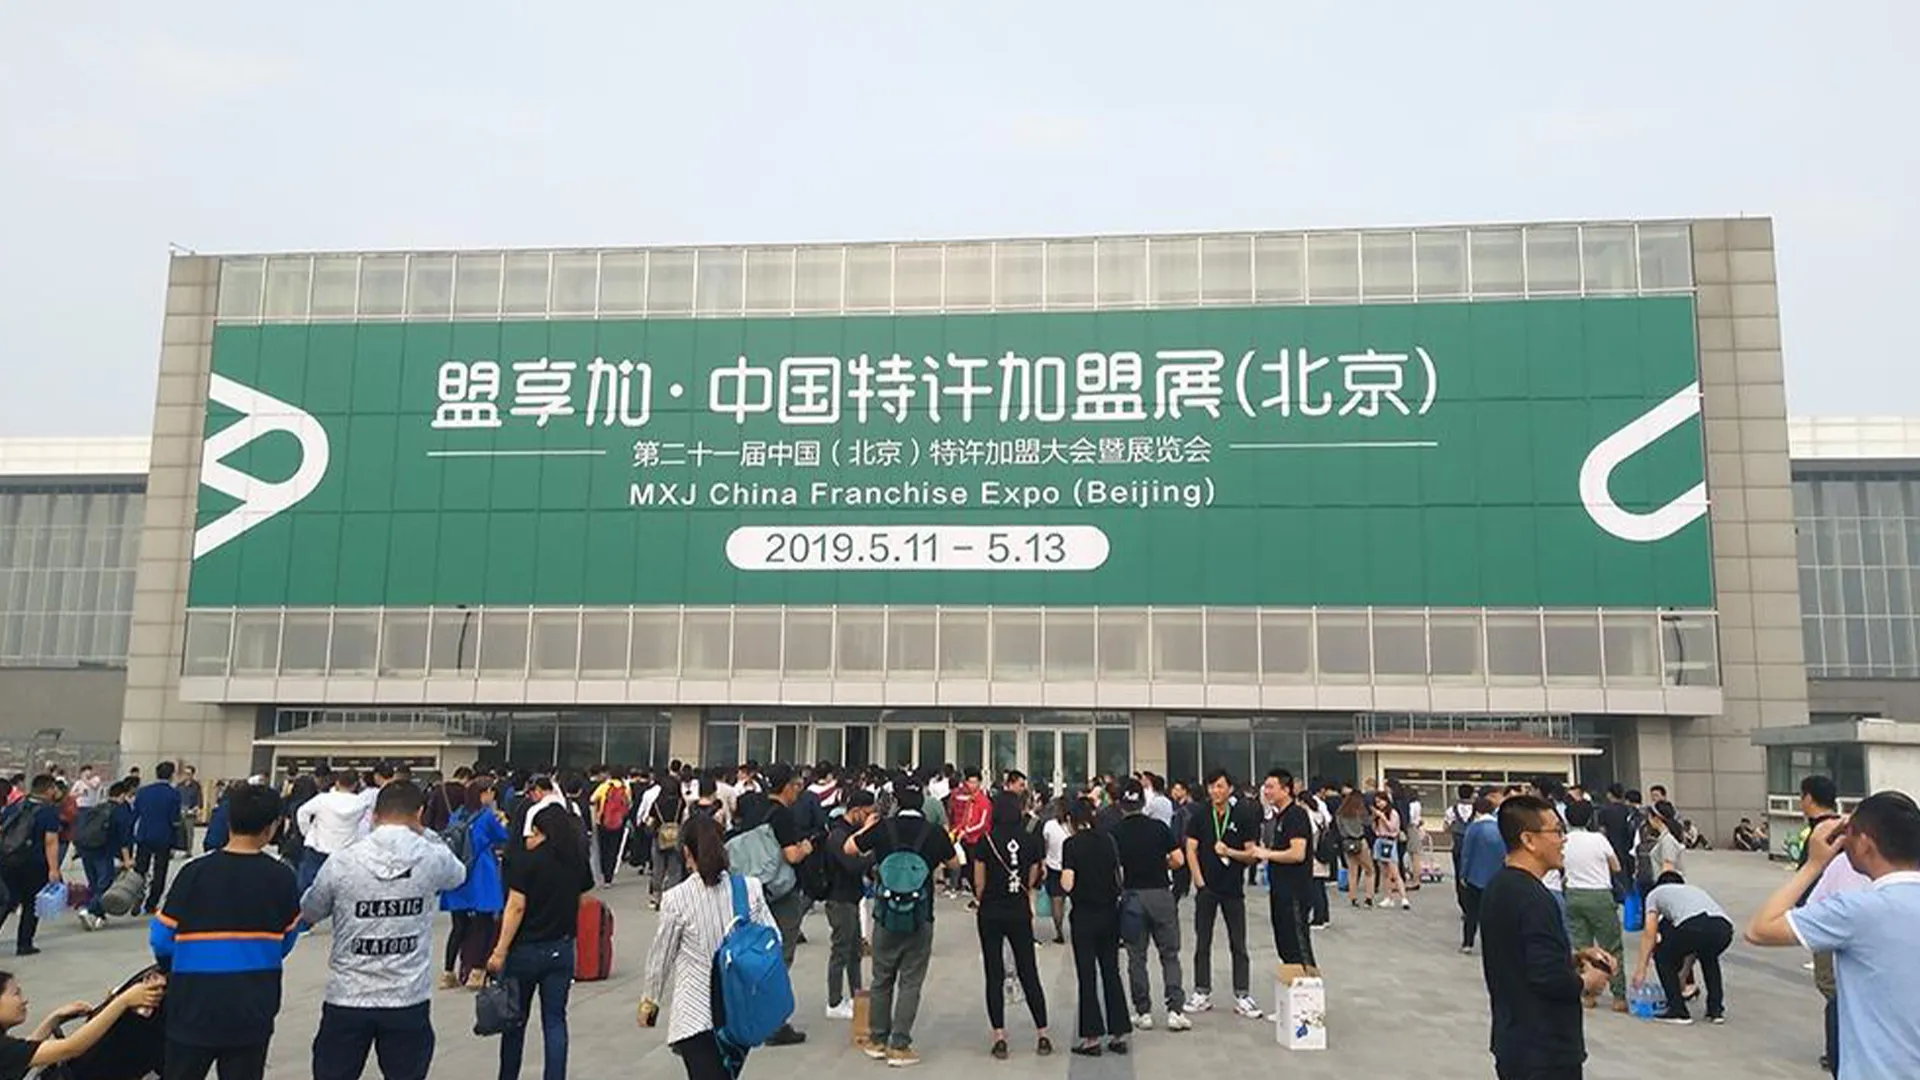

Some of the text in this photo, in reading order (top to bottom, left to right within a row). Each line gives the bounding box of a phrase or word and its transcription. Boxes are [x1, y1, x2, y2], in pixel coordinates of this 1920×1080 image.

[630, 477, 1215, 508] MXJ China Franchise Expo (Beijing)
[765, 533, 937, 563] 2019.5.11
[988, 533, 1066, 563] 5.13
[359, 900, 420, 917] PLASTIC
